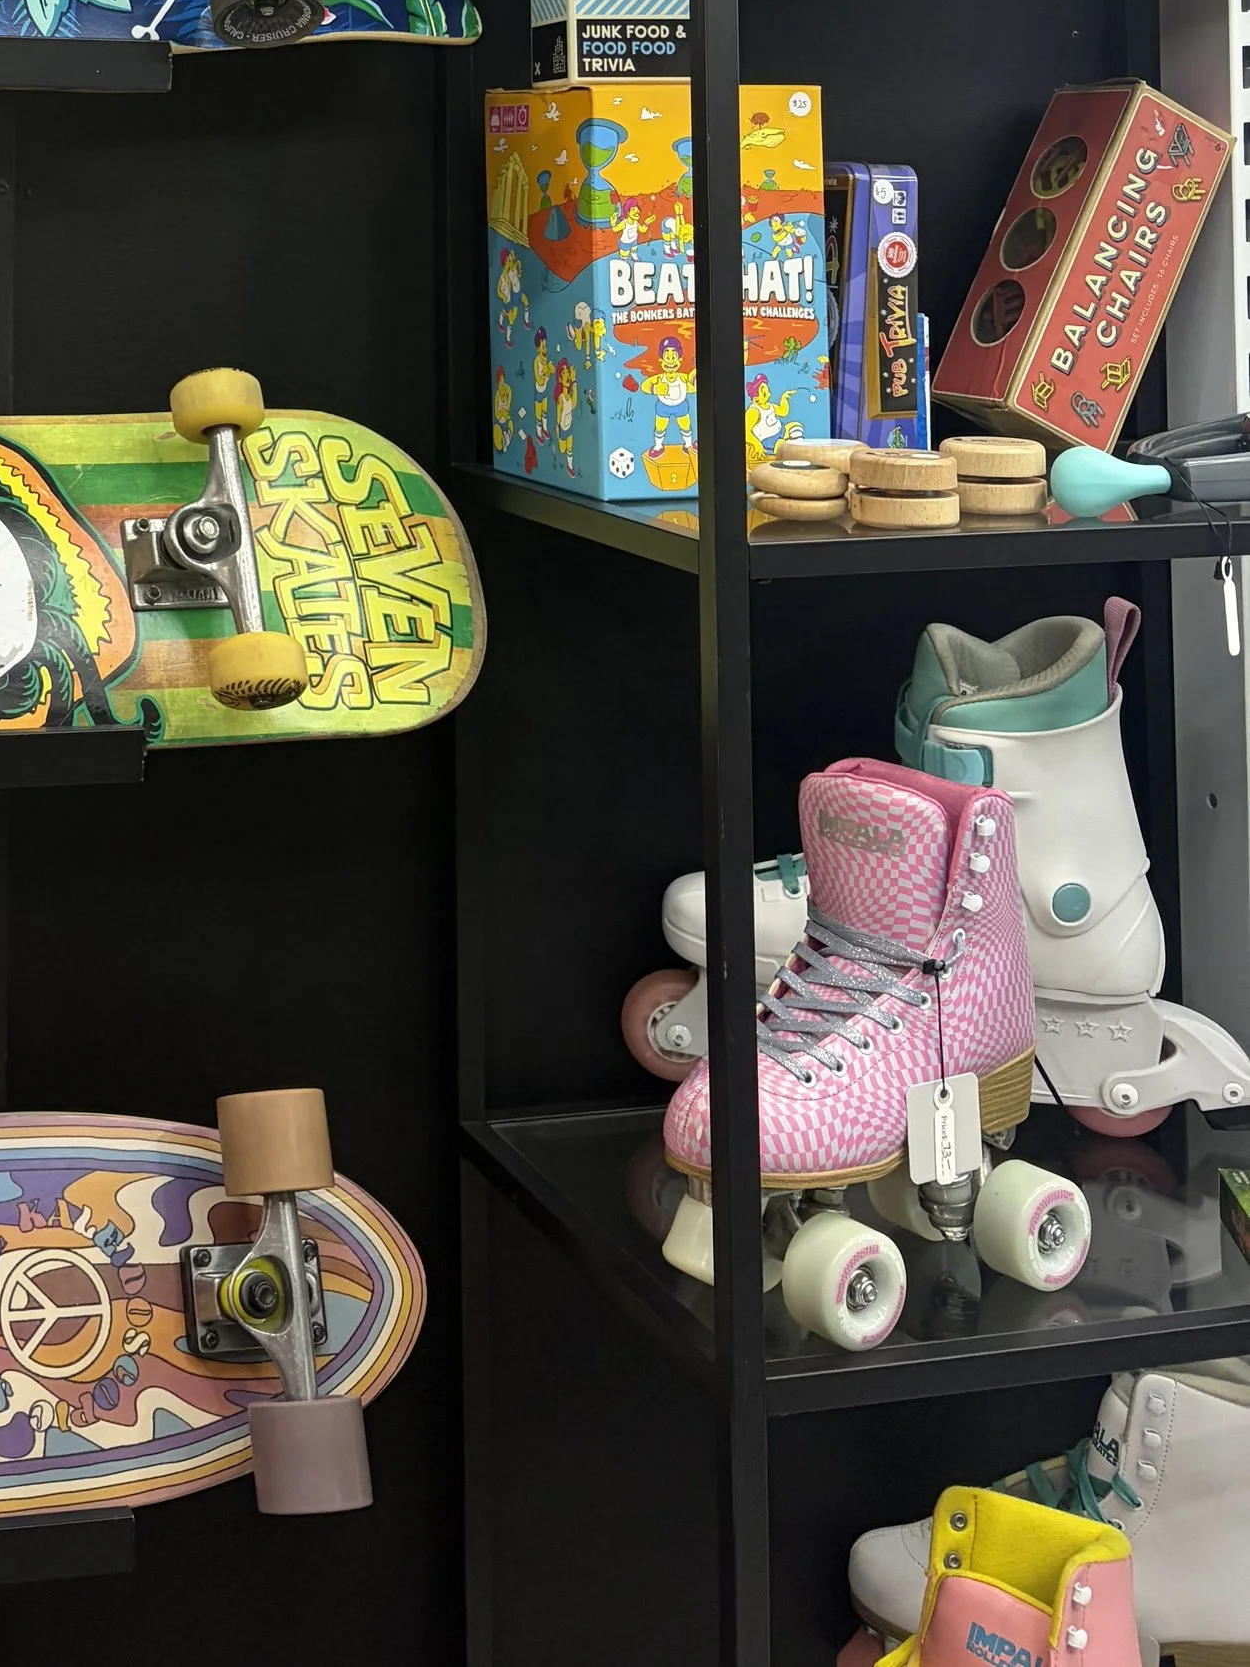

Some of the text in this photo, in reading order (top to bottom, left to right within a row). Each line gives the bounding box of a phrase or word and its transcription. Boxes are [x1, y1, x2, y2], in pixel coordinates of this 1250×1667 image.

[251, 24, 297, 43] CRUISER
[582, 24, 687, 39] JUNK FOOD &
[582, 41, 676, 55] FOOD FOOD
[582, 58, 636, 72] TRIVIA
[791, 99, 808, 109] $25
[1051, 146, 1160, 374] BALANCING
[1161, 234, 1180, 267] CHAIRS
[609, 259, 695, 307] BEAT
[742, 255, 815, 304] HAT!
[1096, 200, 1168, 348] CHAIRS
[1158, 268, 1166, 279] 36
[611, 311, 630, 325] THE
[630, 308, 675, 323] BONKERS
[676, 307, 695, 319] BAT
[760, 305, 816, 320] CHALLENGES
[879, 284, 917, 358] TRIVIA
[1130, 325, 1143, 344] SET
[891, 358, 909, 397] PUB
[671, 473, 678, 483] 2
[242, 427, 374, 712] SKATES
[318, 435, 454, 706] SEVEN
